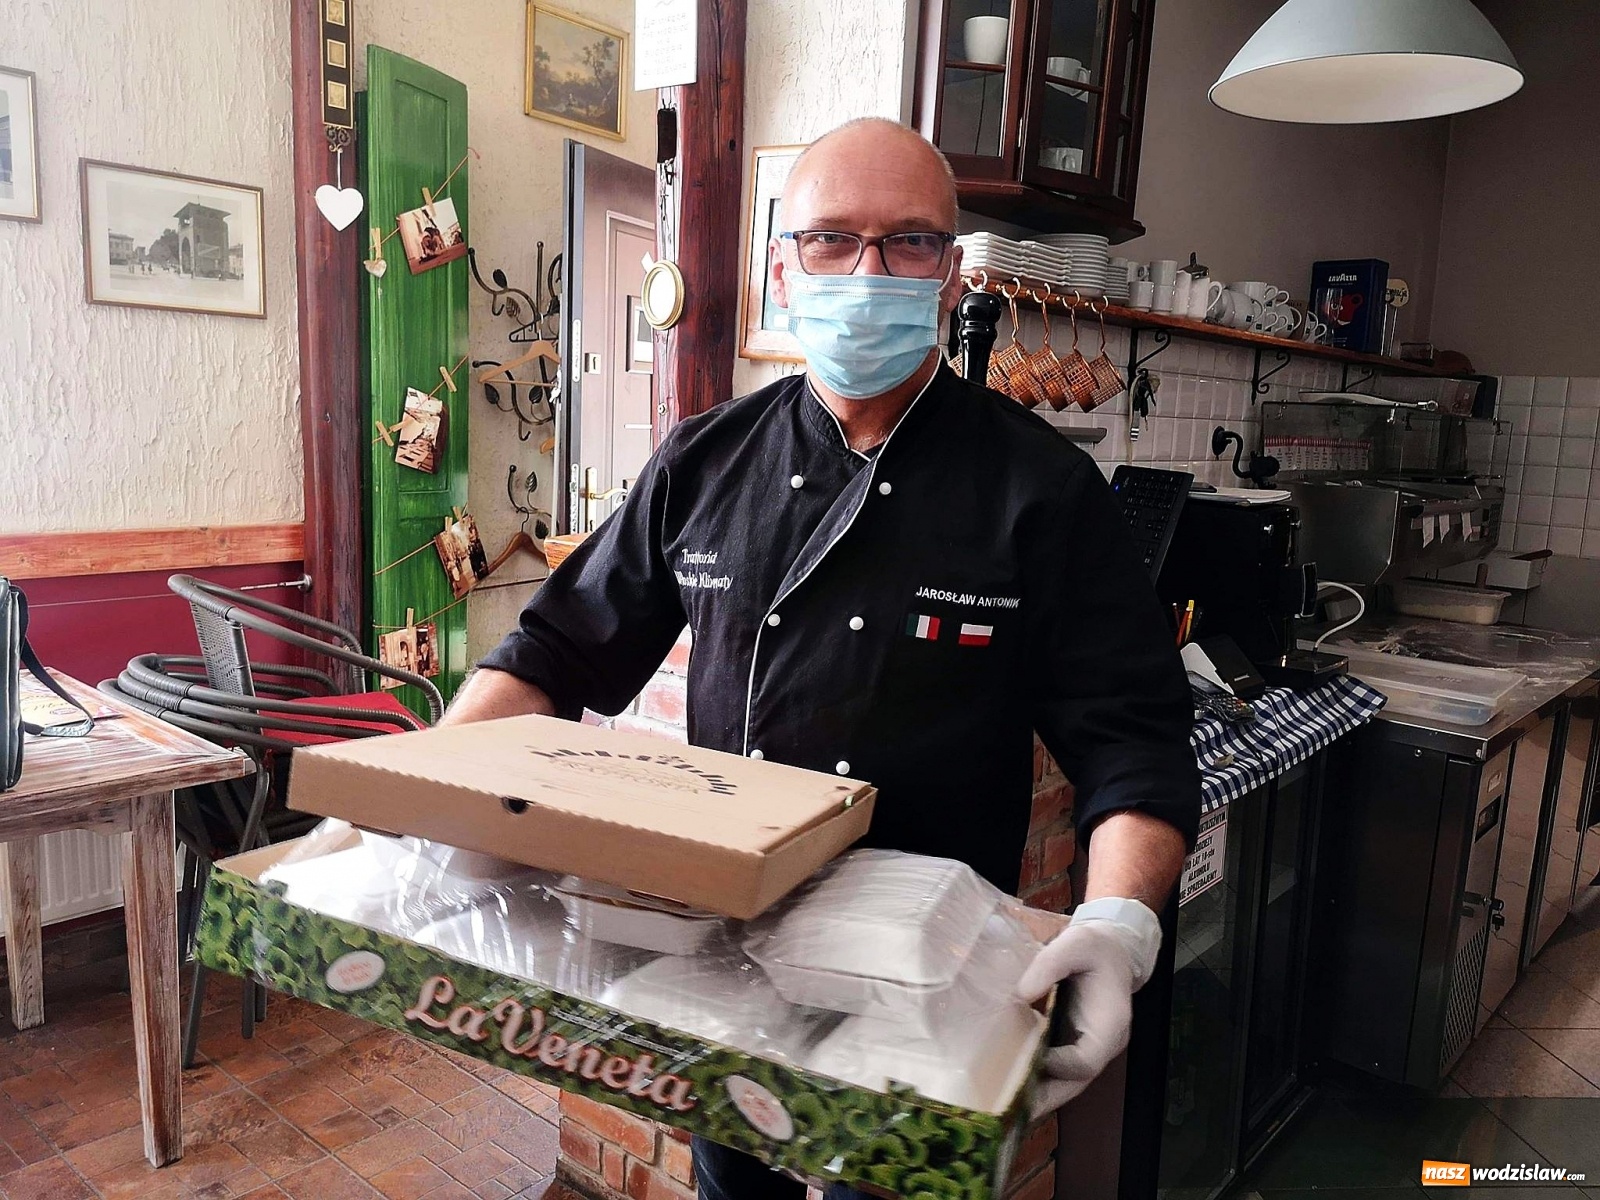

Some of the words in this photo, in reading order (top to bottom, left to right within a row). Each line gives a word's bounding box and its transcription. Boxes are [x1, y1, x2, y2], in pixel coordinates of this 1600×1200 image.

[1328, 273, 1357, 282] LAVAZZA
[682, 549, 718, 565] Trattoria
[916, 586, 976, 606] JAROSŁAW
[977, 596, 1021, 609] ANTONIK
[404, 975, 489, 1041] La
[493, 997, 698, 1111] Veneta
